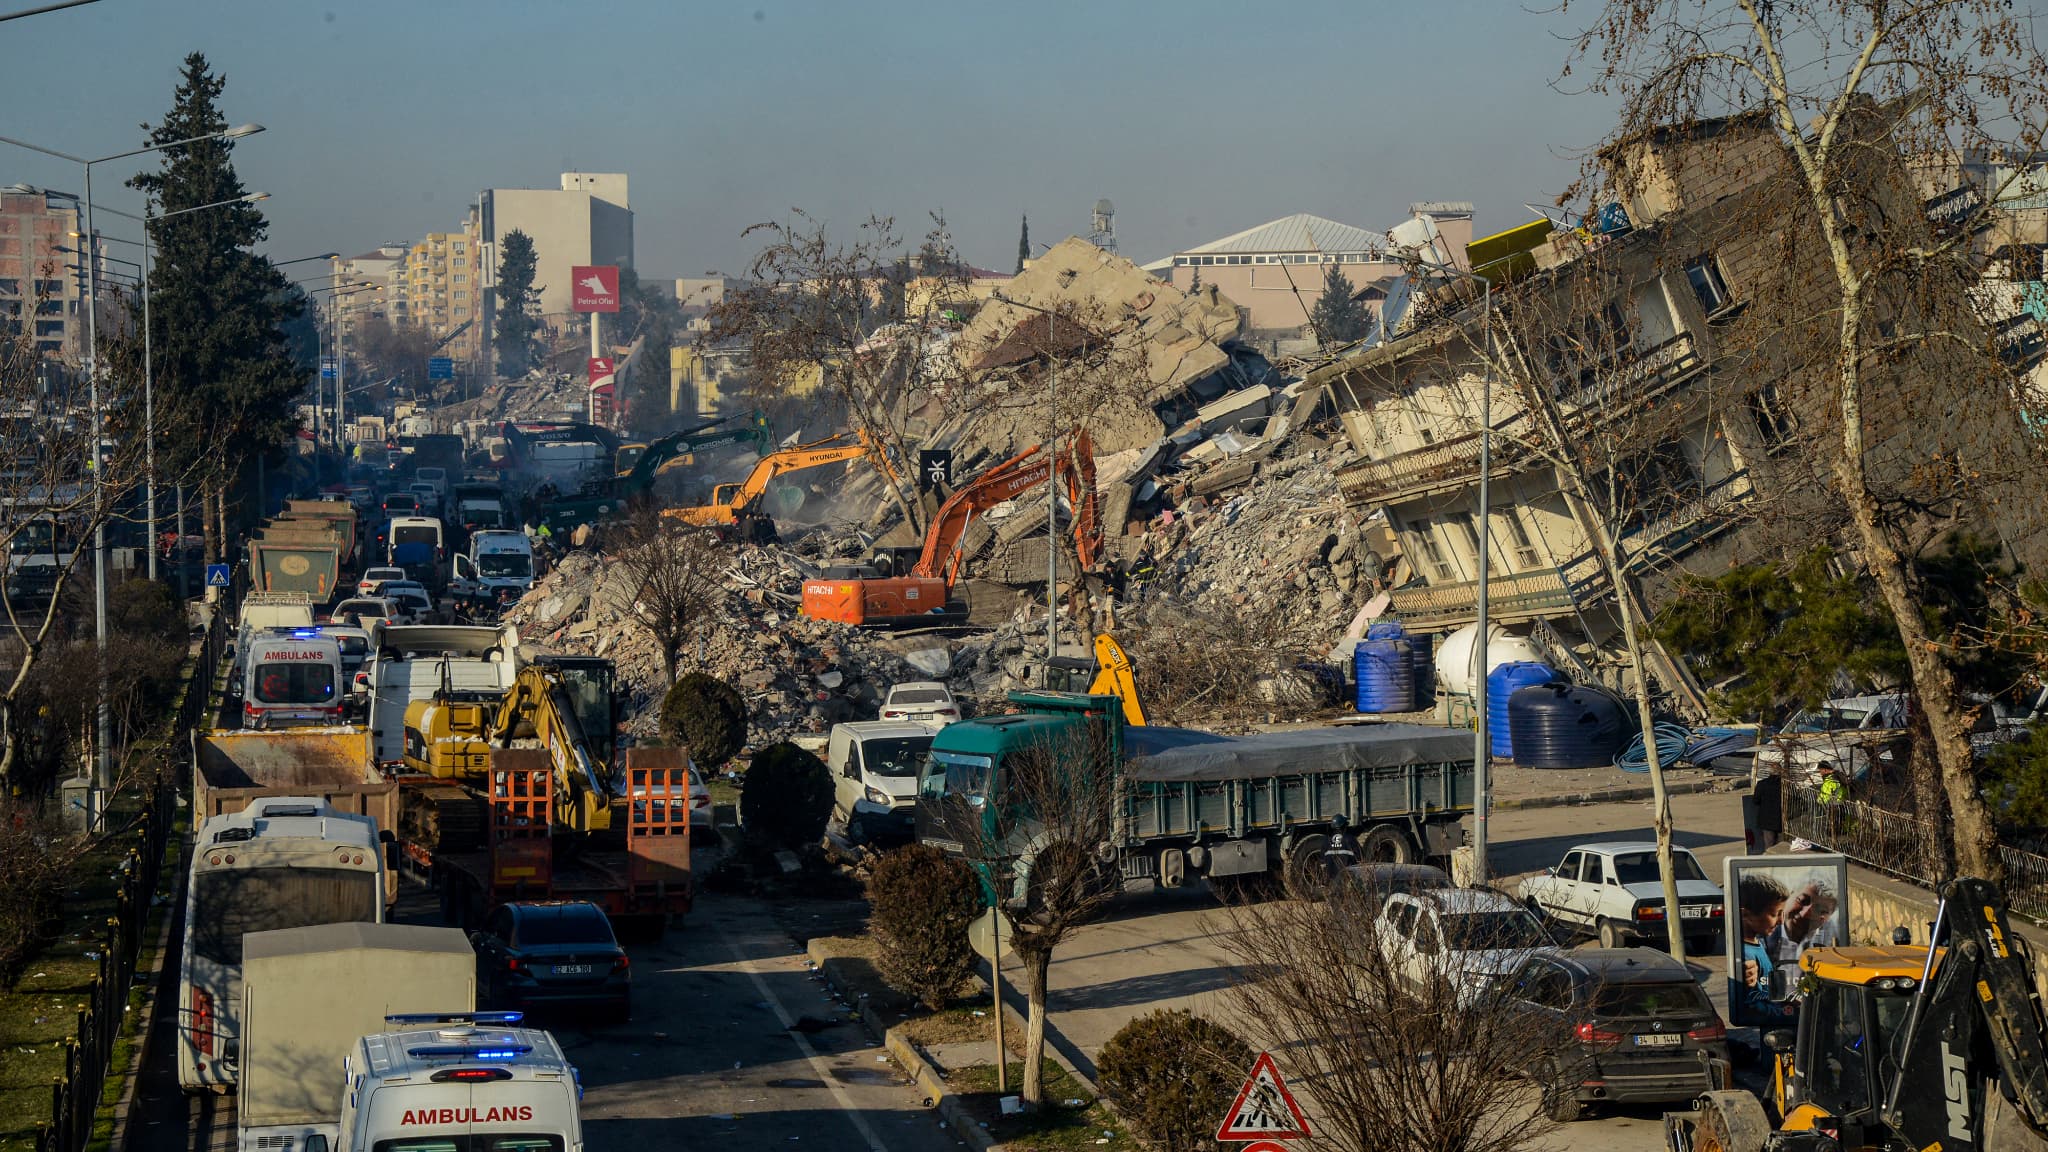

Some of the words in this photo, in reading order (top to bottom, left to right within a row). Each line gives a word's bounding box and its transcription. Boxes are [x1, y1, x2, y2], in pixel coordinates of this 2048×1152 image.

[539, 432, 571, 440] VOLVO
[809, 452, 843, 462] HYUNDAI
[1008, 467, 1047, 490] HITACHI
[807, 585, 833, 595] HITACHI
[264, 651, 323, 660] AMBULANS
[1985, 928, 2001, 958] PLUS
[1639, 1035, 1648, 1045] 34
[1653, 1035, 1659, 1044] D
[1663, 1034, 1680, 1044] 1444
[1941, 1041, 1972, 1142] MST
[400, 1106, 533, 1126] AMBULANS
